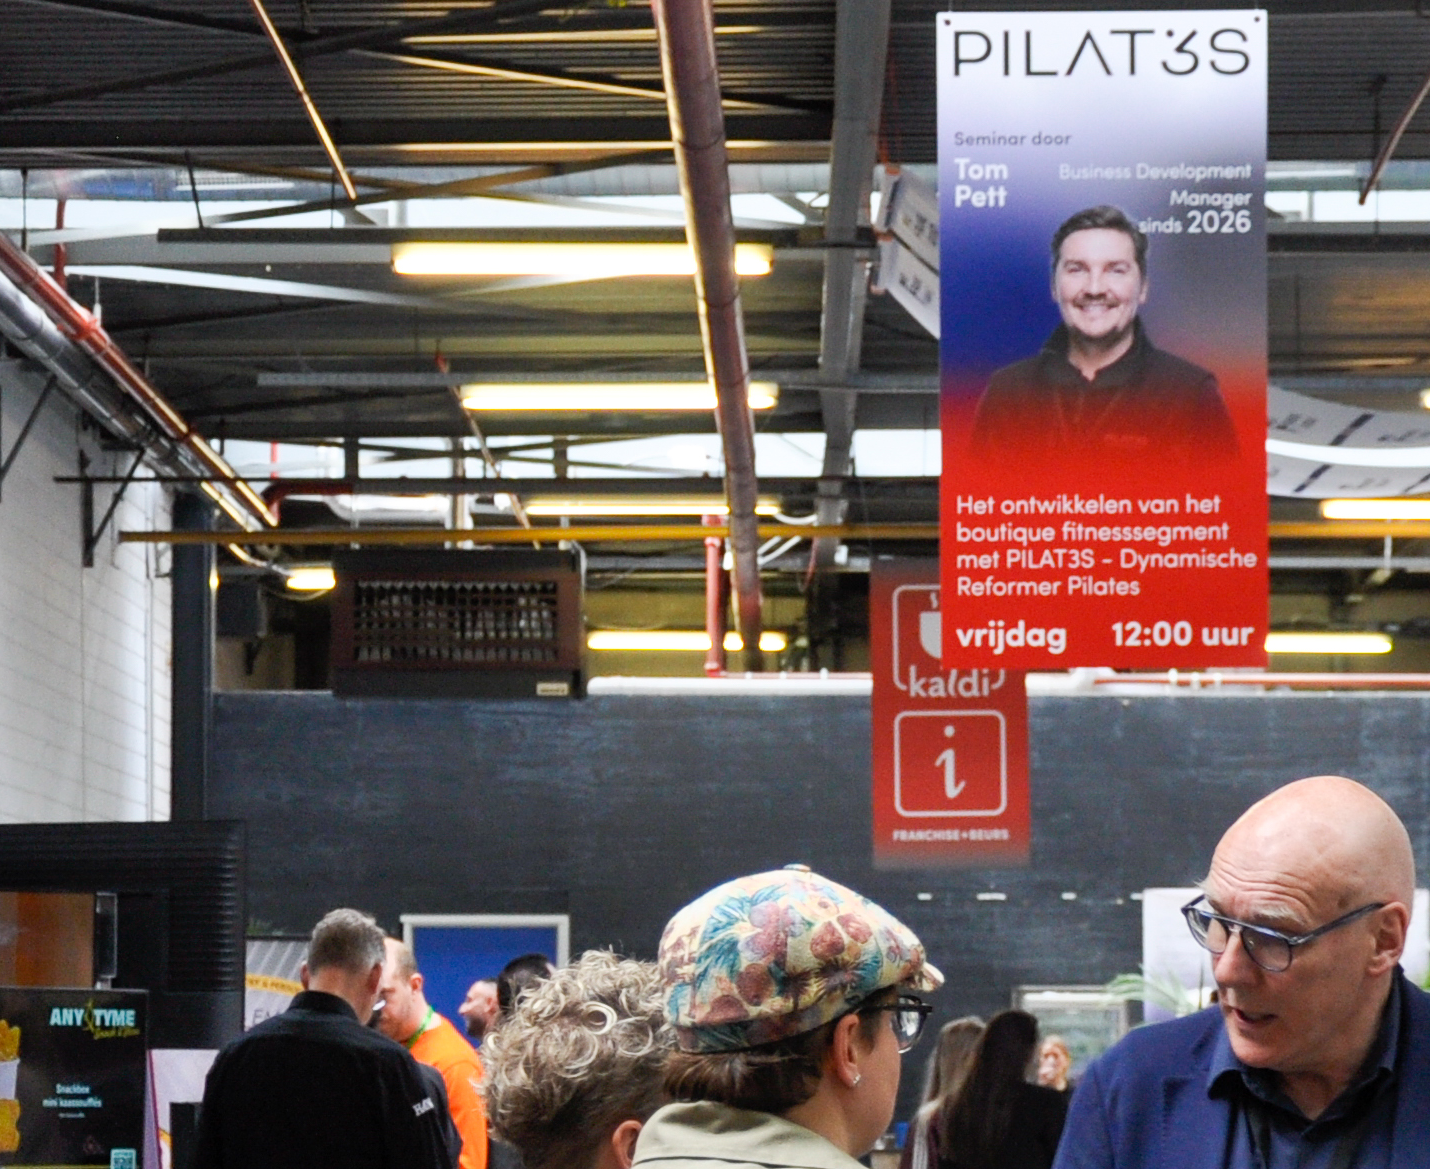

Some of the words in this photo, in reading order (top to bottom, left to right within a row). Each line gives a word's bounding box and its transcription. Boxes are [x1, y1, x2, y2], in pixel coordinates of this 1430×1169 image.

[954, 131, 1027, 147] Seminar
[1031, 131, 1072, 147] door
[954, 157, 1008, 181] Tom
[1059, 163, 1131, 180] Business
[1136, 163, 1252, 184] Development
[954, 184, 1007, 208] Pett
[1170, 189, 1252, 209] Manager
[1138, 218, 1182, 234] sinds
[1187, 210, 1251, 234] 2026
[957, 495, 996, 515] Het
[1001, 495, 1132, 515] ontwikkelen
[1138, 498, 1179, 514] van
[1186, 494, 1220, 514] het
[956, 522, 1055, 546] boutique
[1062, 521, 1229, 547] fitnesssegment
[957, 552, 999, 569] met
[1006, 549, 1095, 569] PILAT3S
[1120, 548, 1257, 573] Dynamische
[957, 576, 1061, 597] Reformer
[1068, 575, 1140, 596] Pilates
[956, 619, 1067, 654] vrijdag
[1112, 621, 1193, 646] 12:00
[1202, 625, 1254, 646] uur
[909, 665, 990, 698] kaldi
